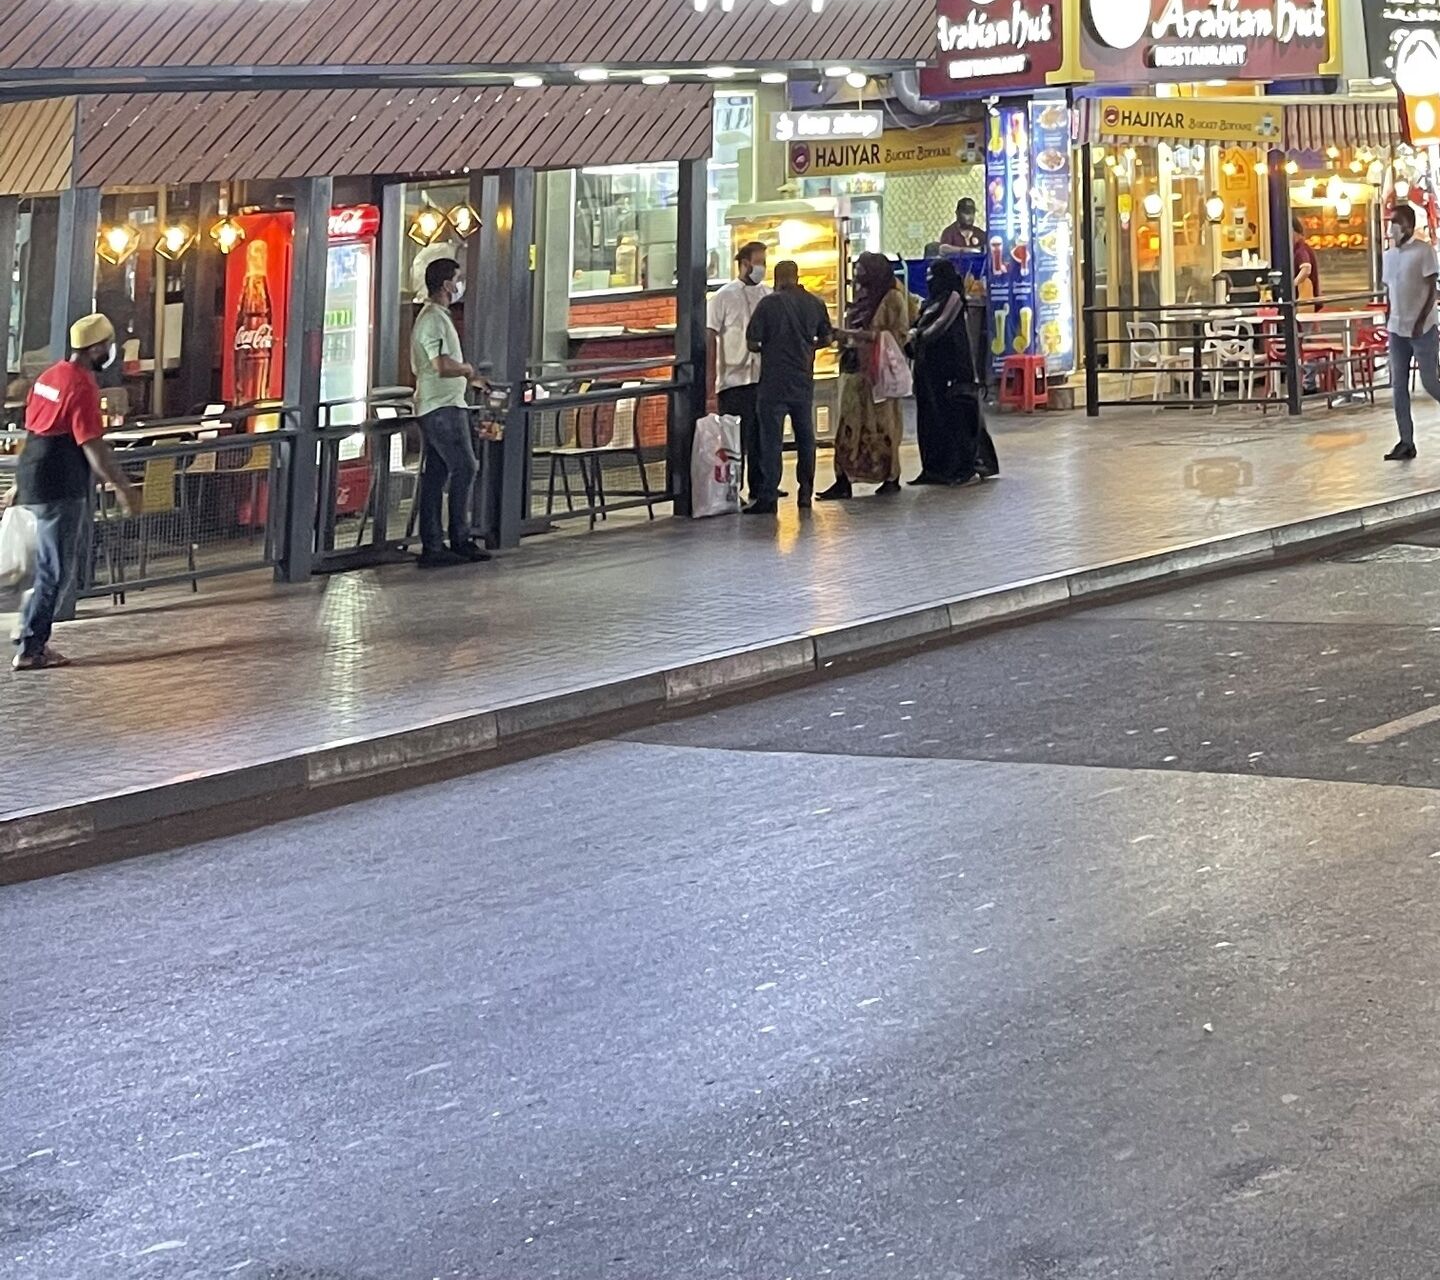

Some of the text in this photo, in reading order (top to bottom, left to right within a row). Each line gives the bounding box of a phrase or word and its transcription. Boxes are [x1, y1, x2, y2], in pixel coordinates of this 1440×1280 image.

[1154, 45, 1247, 66] RESTAURANT
[1121, 110, 1184, 129] HAJIYAR
[815, 143, 880, 168] HAJIYAR
